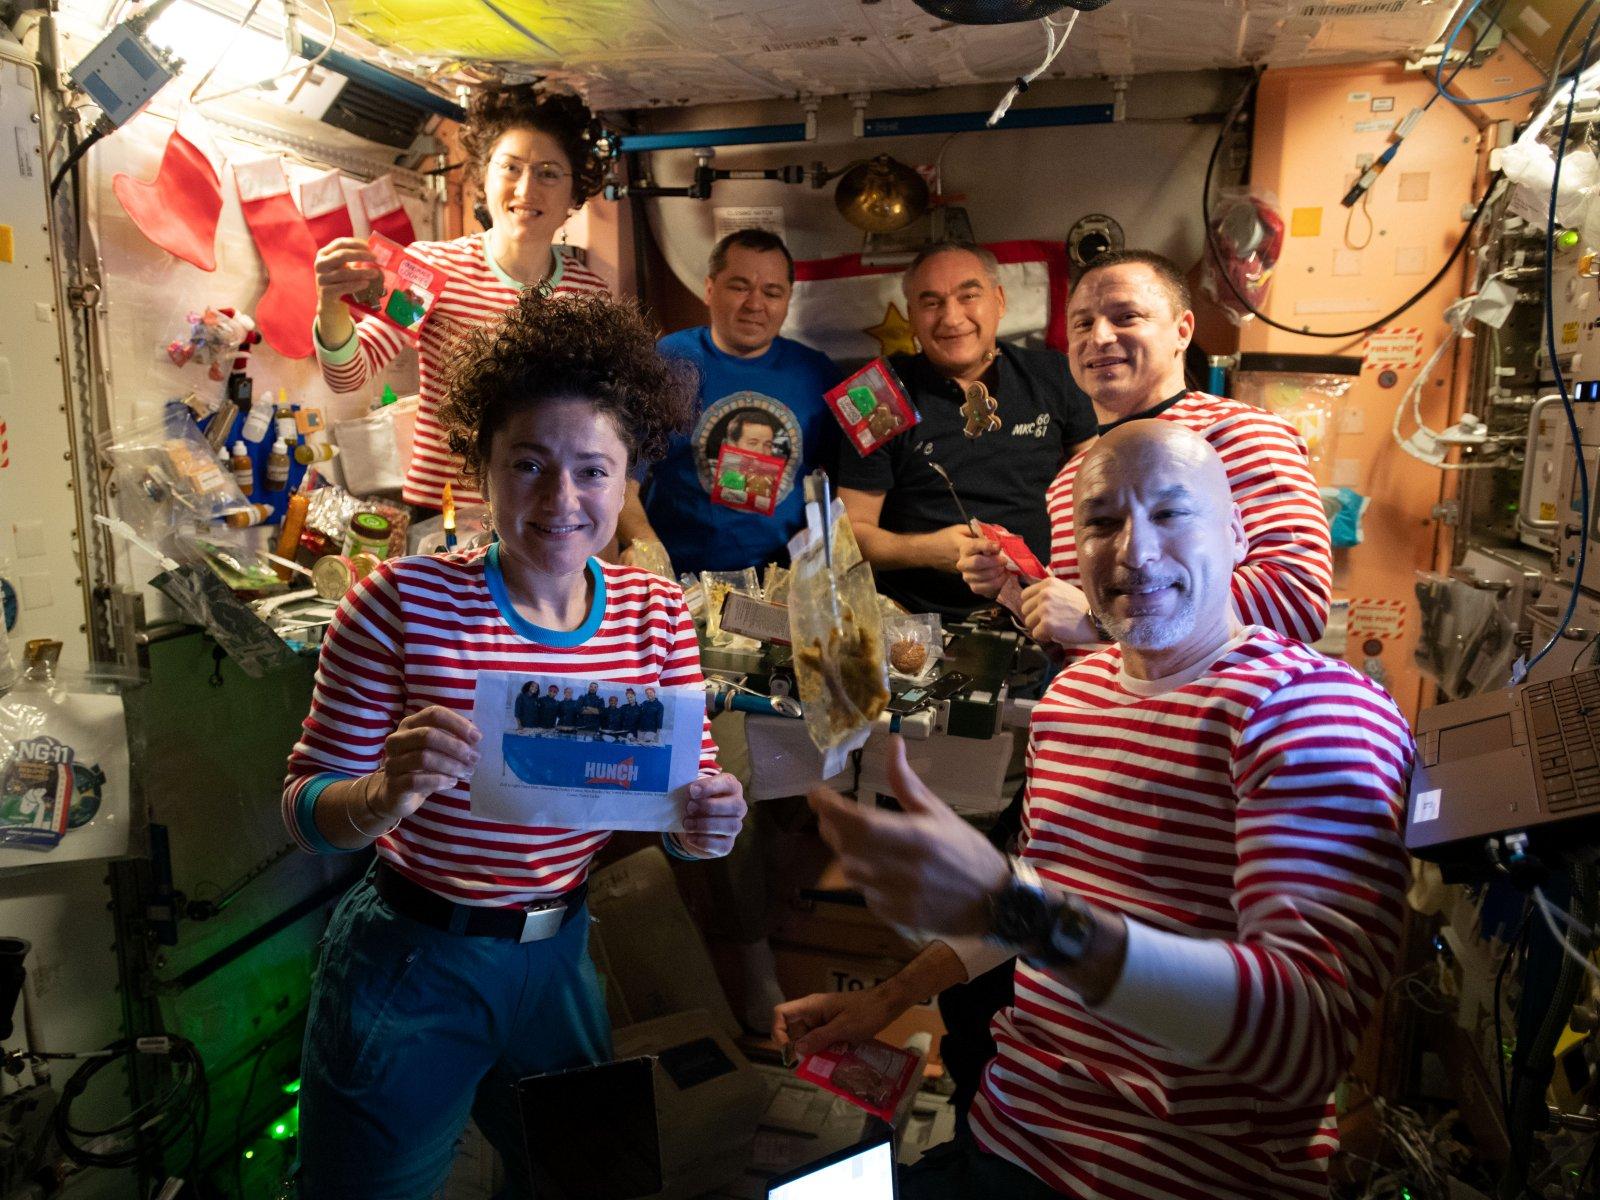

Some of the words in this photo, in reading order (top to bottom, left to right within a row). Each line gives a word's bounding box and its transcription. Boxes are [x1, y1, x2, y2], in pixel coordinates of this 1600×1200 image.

[1036, 412, 1050, 426] 60
[1034, 426, 1048, 438] 61
[585, 761, 639, 781] HUNCH
